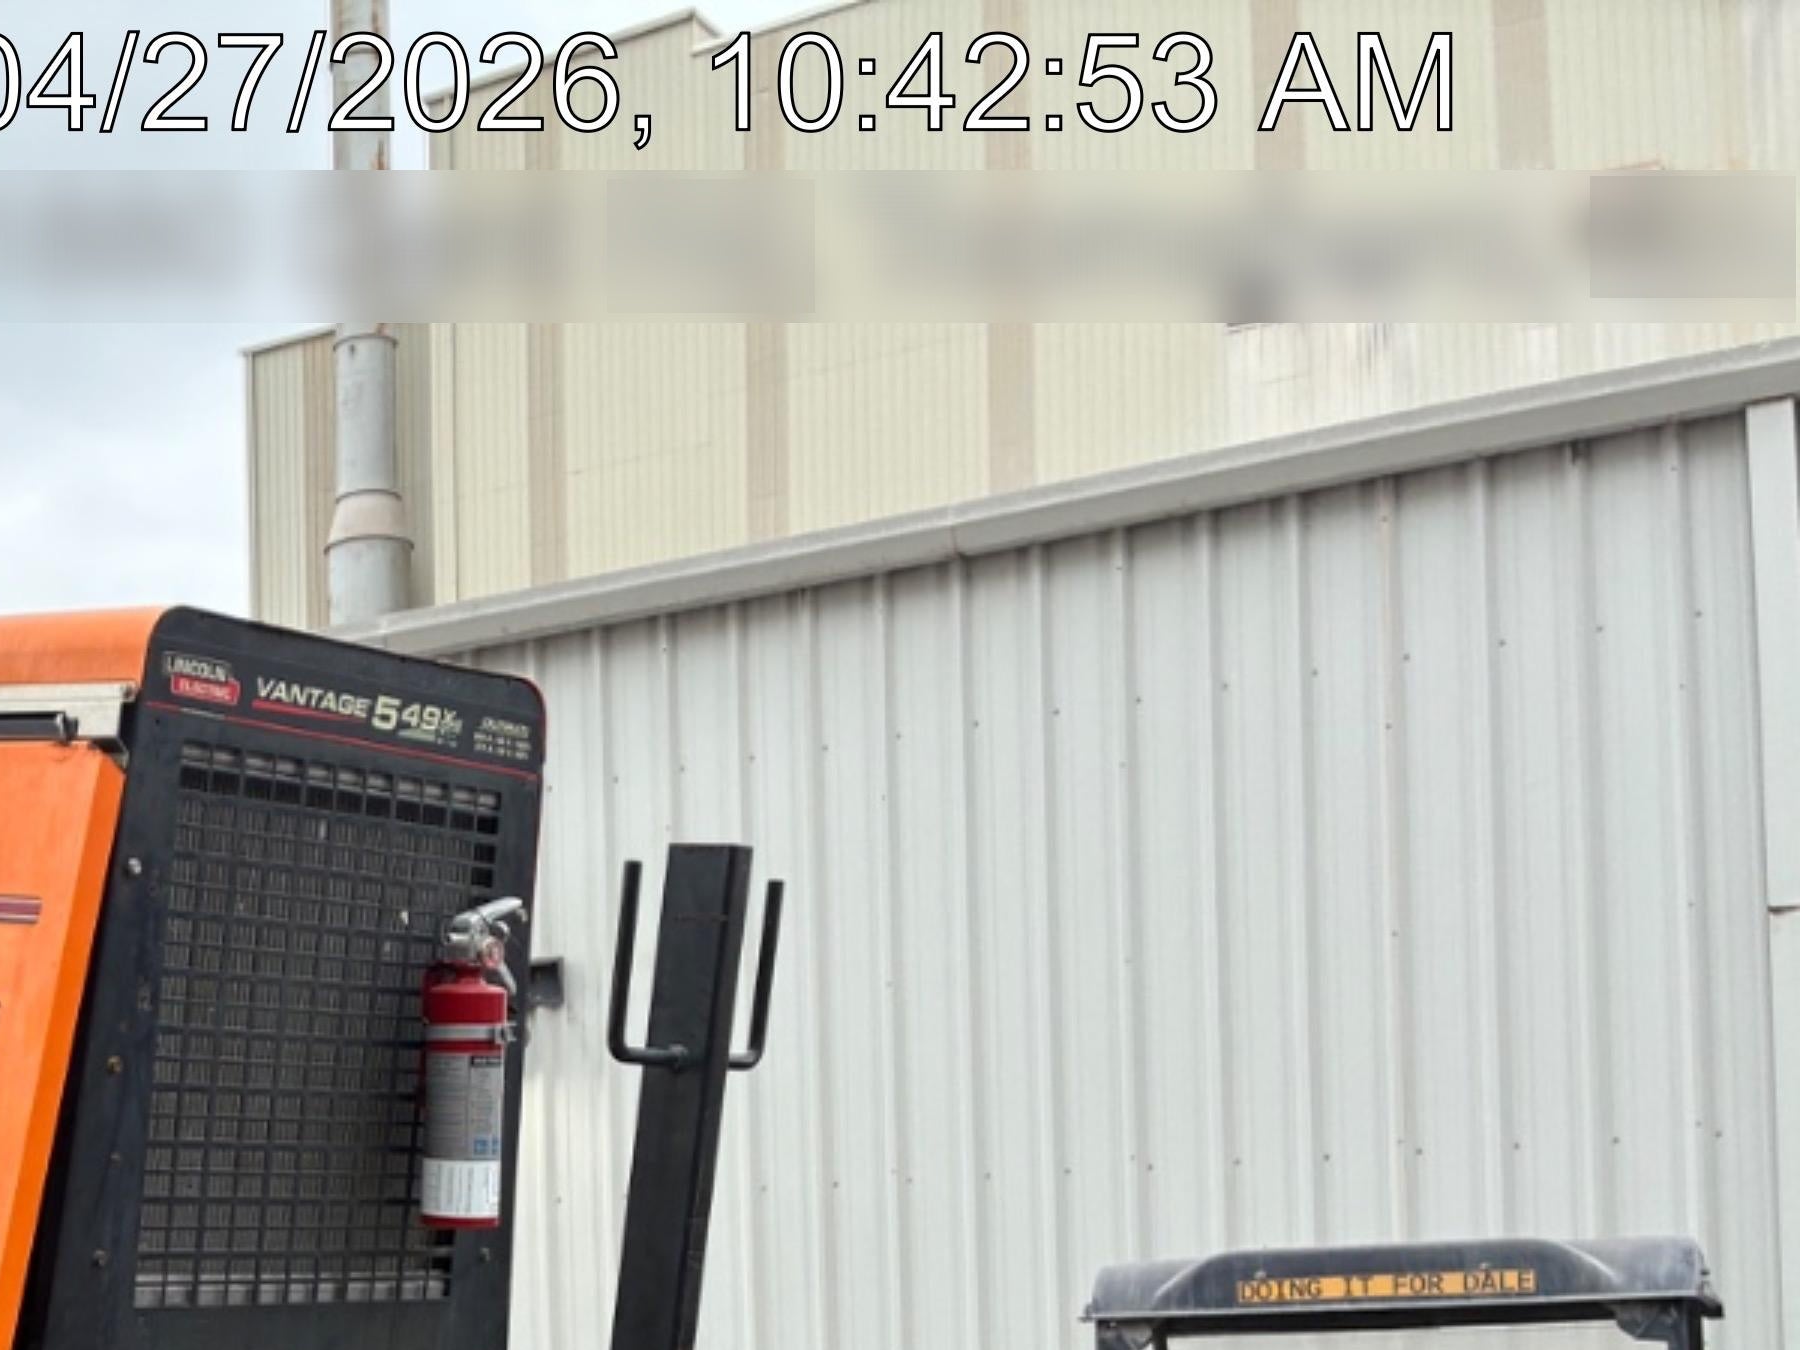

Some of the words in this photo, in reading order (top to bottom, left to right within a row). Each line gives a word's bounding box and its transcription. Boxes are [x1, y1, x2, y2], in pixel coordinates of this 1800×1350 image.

[257, 676, 371, 718] VANTAGE
[1240, 1278, 1321, 1301] DOING
[1343, 1276, 1371, 1297] IT
[1394, 1273, 1444, 1295] FOR
[1464, 1270, 1534, 1293] DALE
